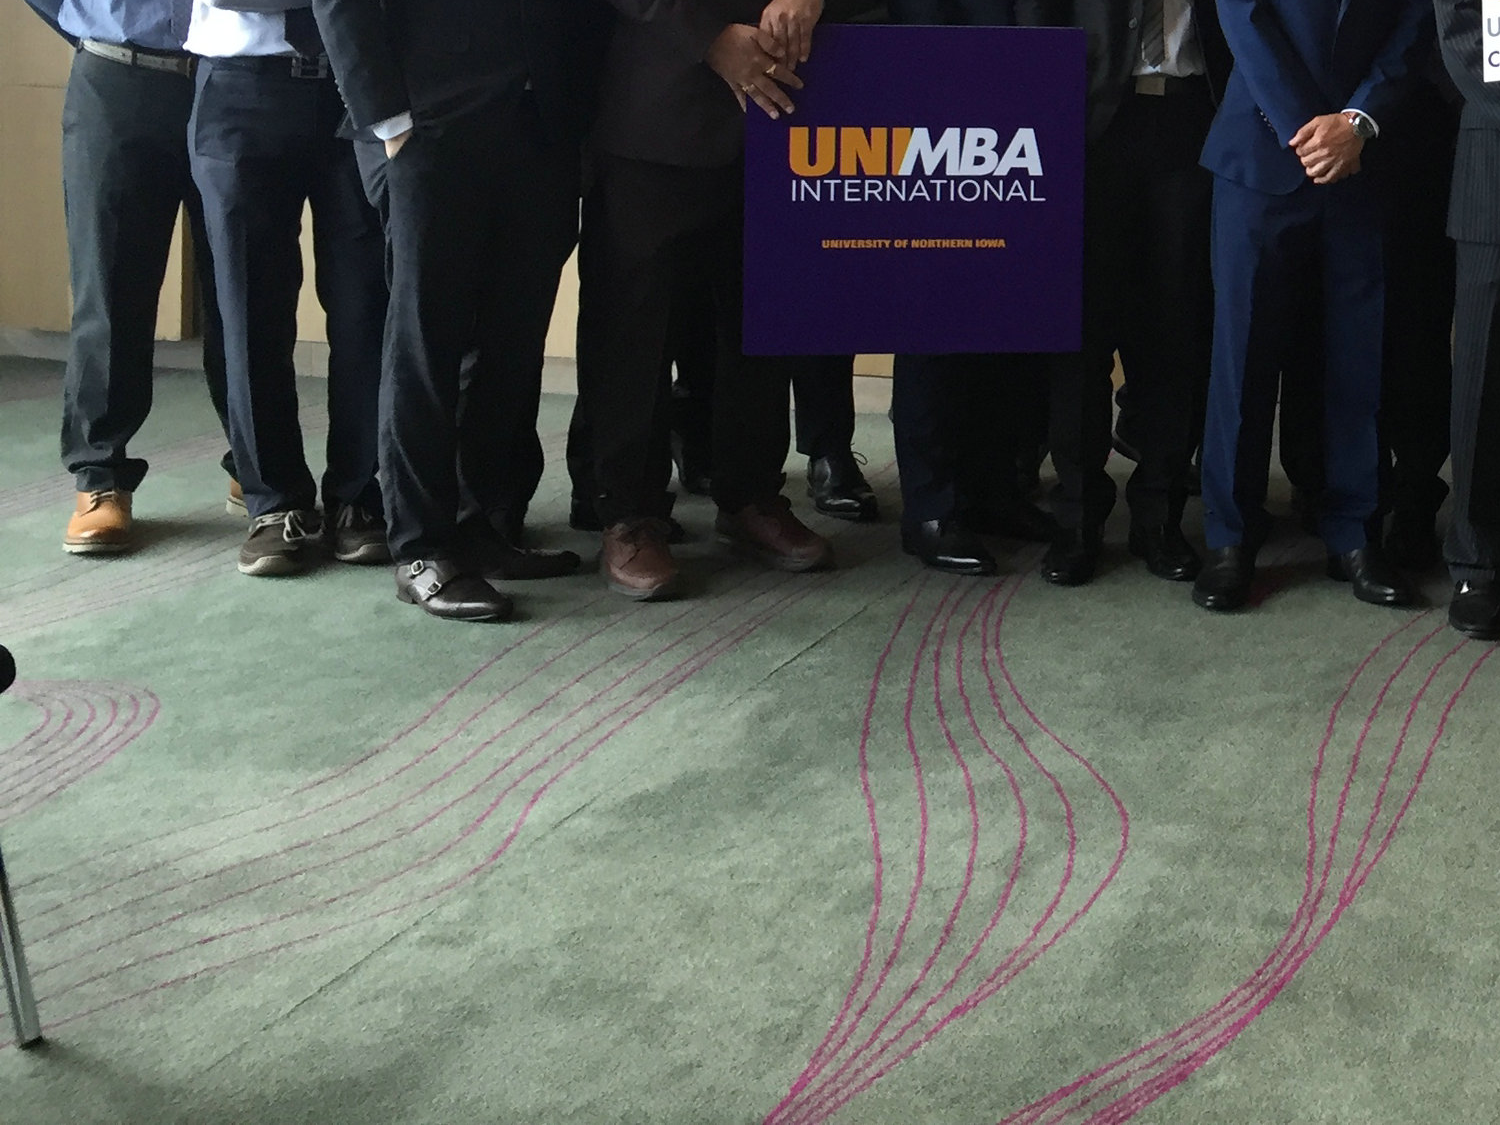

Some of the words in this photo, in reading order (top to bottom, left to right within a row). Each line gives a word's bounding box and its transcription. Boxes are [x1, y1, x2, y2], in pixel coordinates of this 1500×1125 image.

[792, 180, 1046, 202] INTERNATIONAL
[821, 239, 891, 248] UNIVERSITY
[894, 239, 908, 248] OF
[911, 239, 972, 248] NORTHERN
[975, 239, 1006, 248] IOWA
